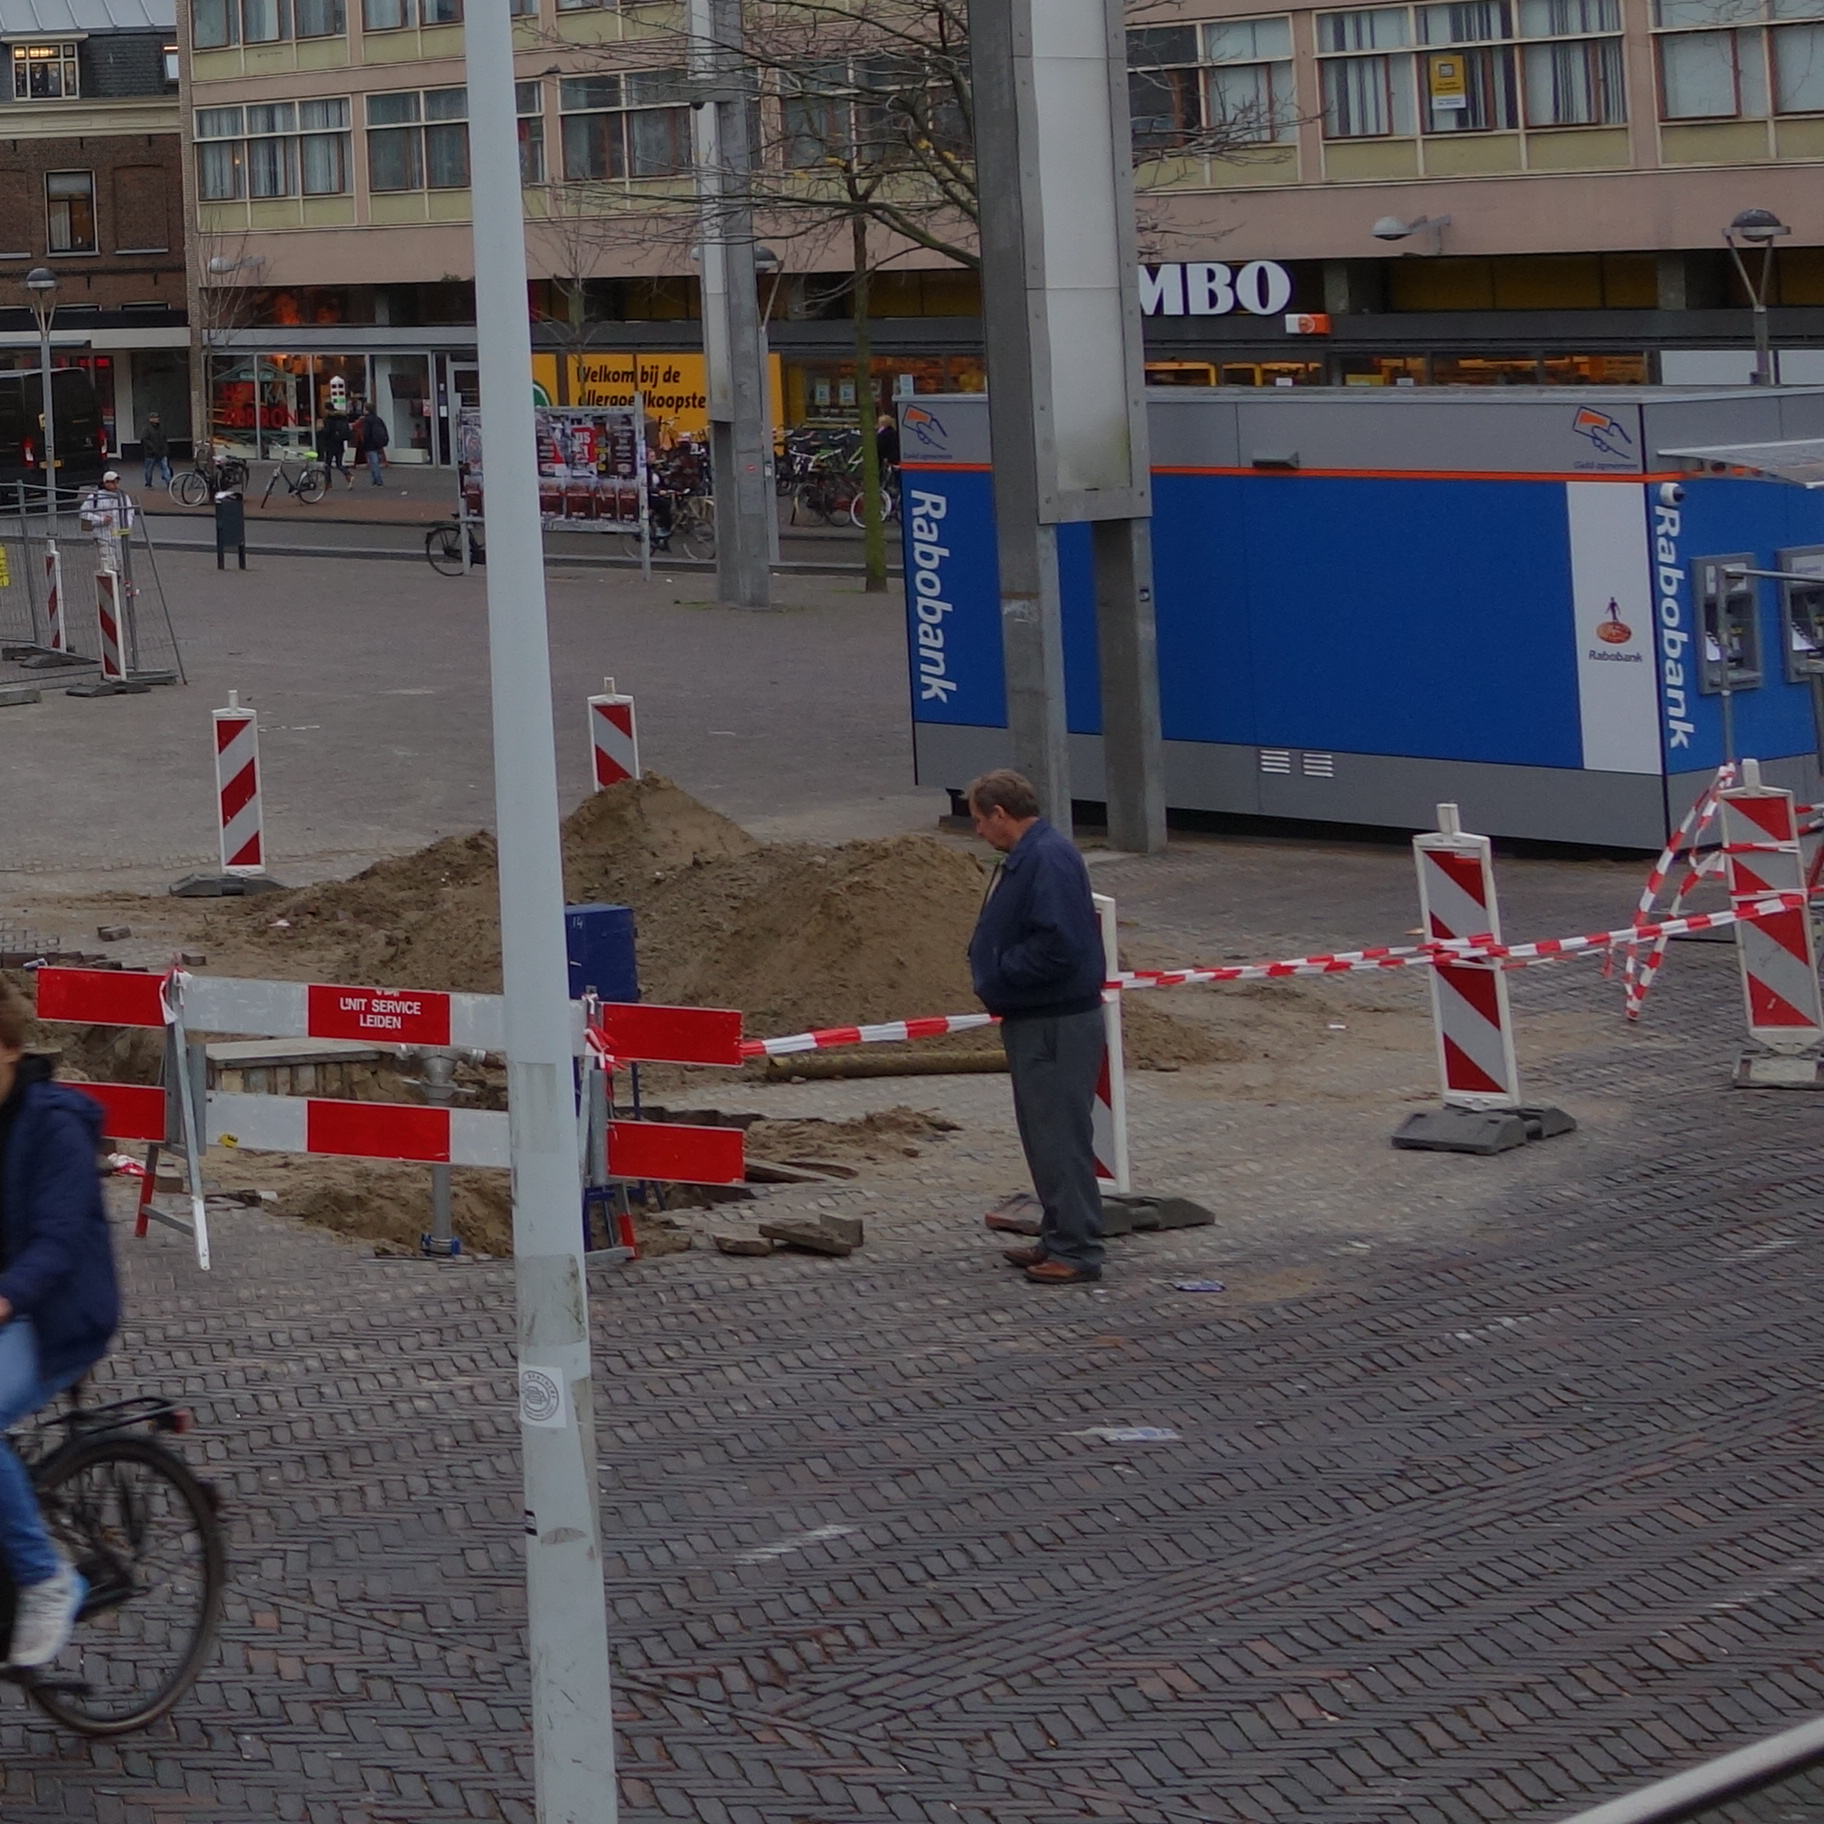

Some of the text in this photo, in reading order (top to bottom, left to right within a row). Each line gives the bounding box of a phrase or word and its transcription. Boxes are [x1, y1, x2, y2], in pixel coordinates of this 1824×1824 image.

[576, 365, 681, 389] Welkom bij de
[910, 489, 958, 703] Rabobank
[1655, 505, 1695, 748] Rabobank
[1588, 650, 1643, 662] Rabobank
[340, 997, 421, 1015] UNIT SERVICE
[360, 1014, 401, 1029] LEIDEN
